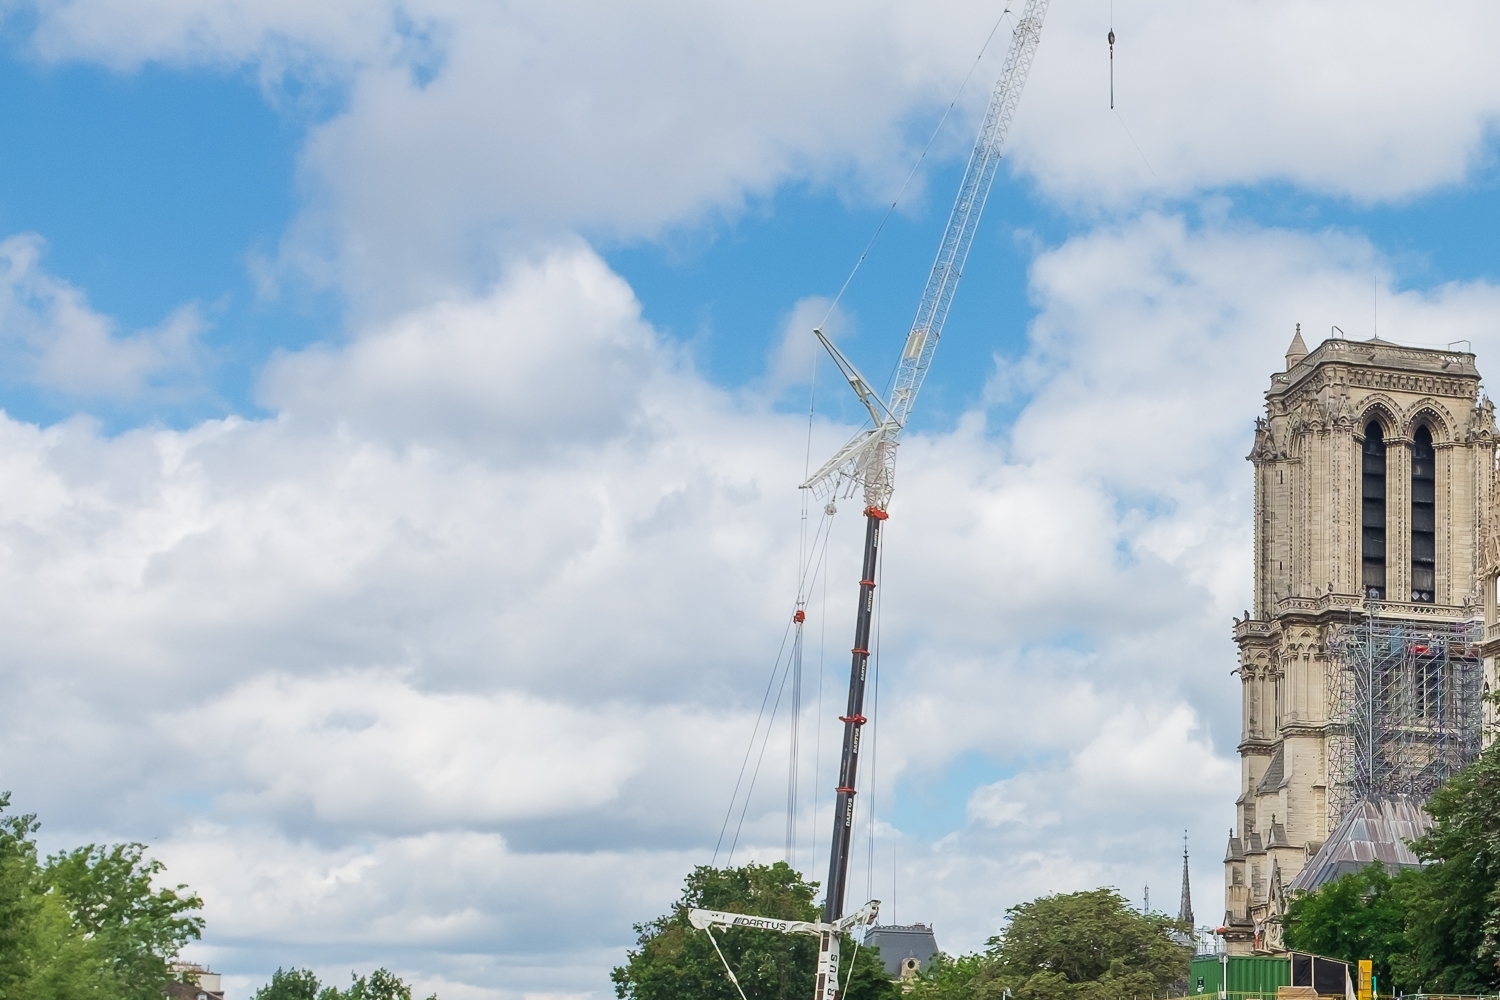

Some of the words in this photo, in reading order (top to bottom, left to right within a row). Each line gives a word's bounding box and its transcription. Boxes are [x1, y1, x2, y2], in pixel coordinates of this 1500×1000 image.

[852, 727, 860, 754] DARTUS
[845, 797, 853, 827] DARTUS
[740, 917, 787, 931] DARTUS
